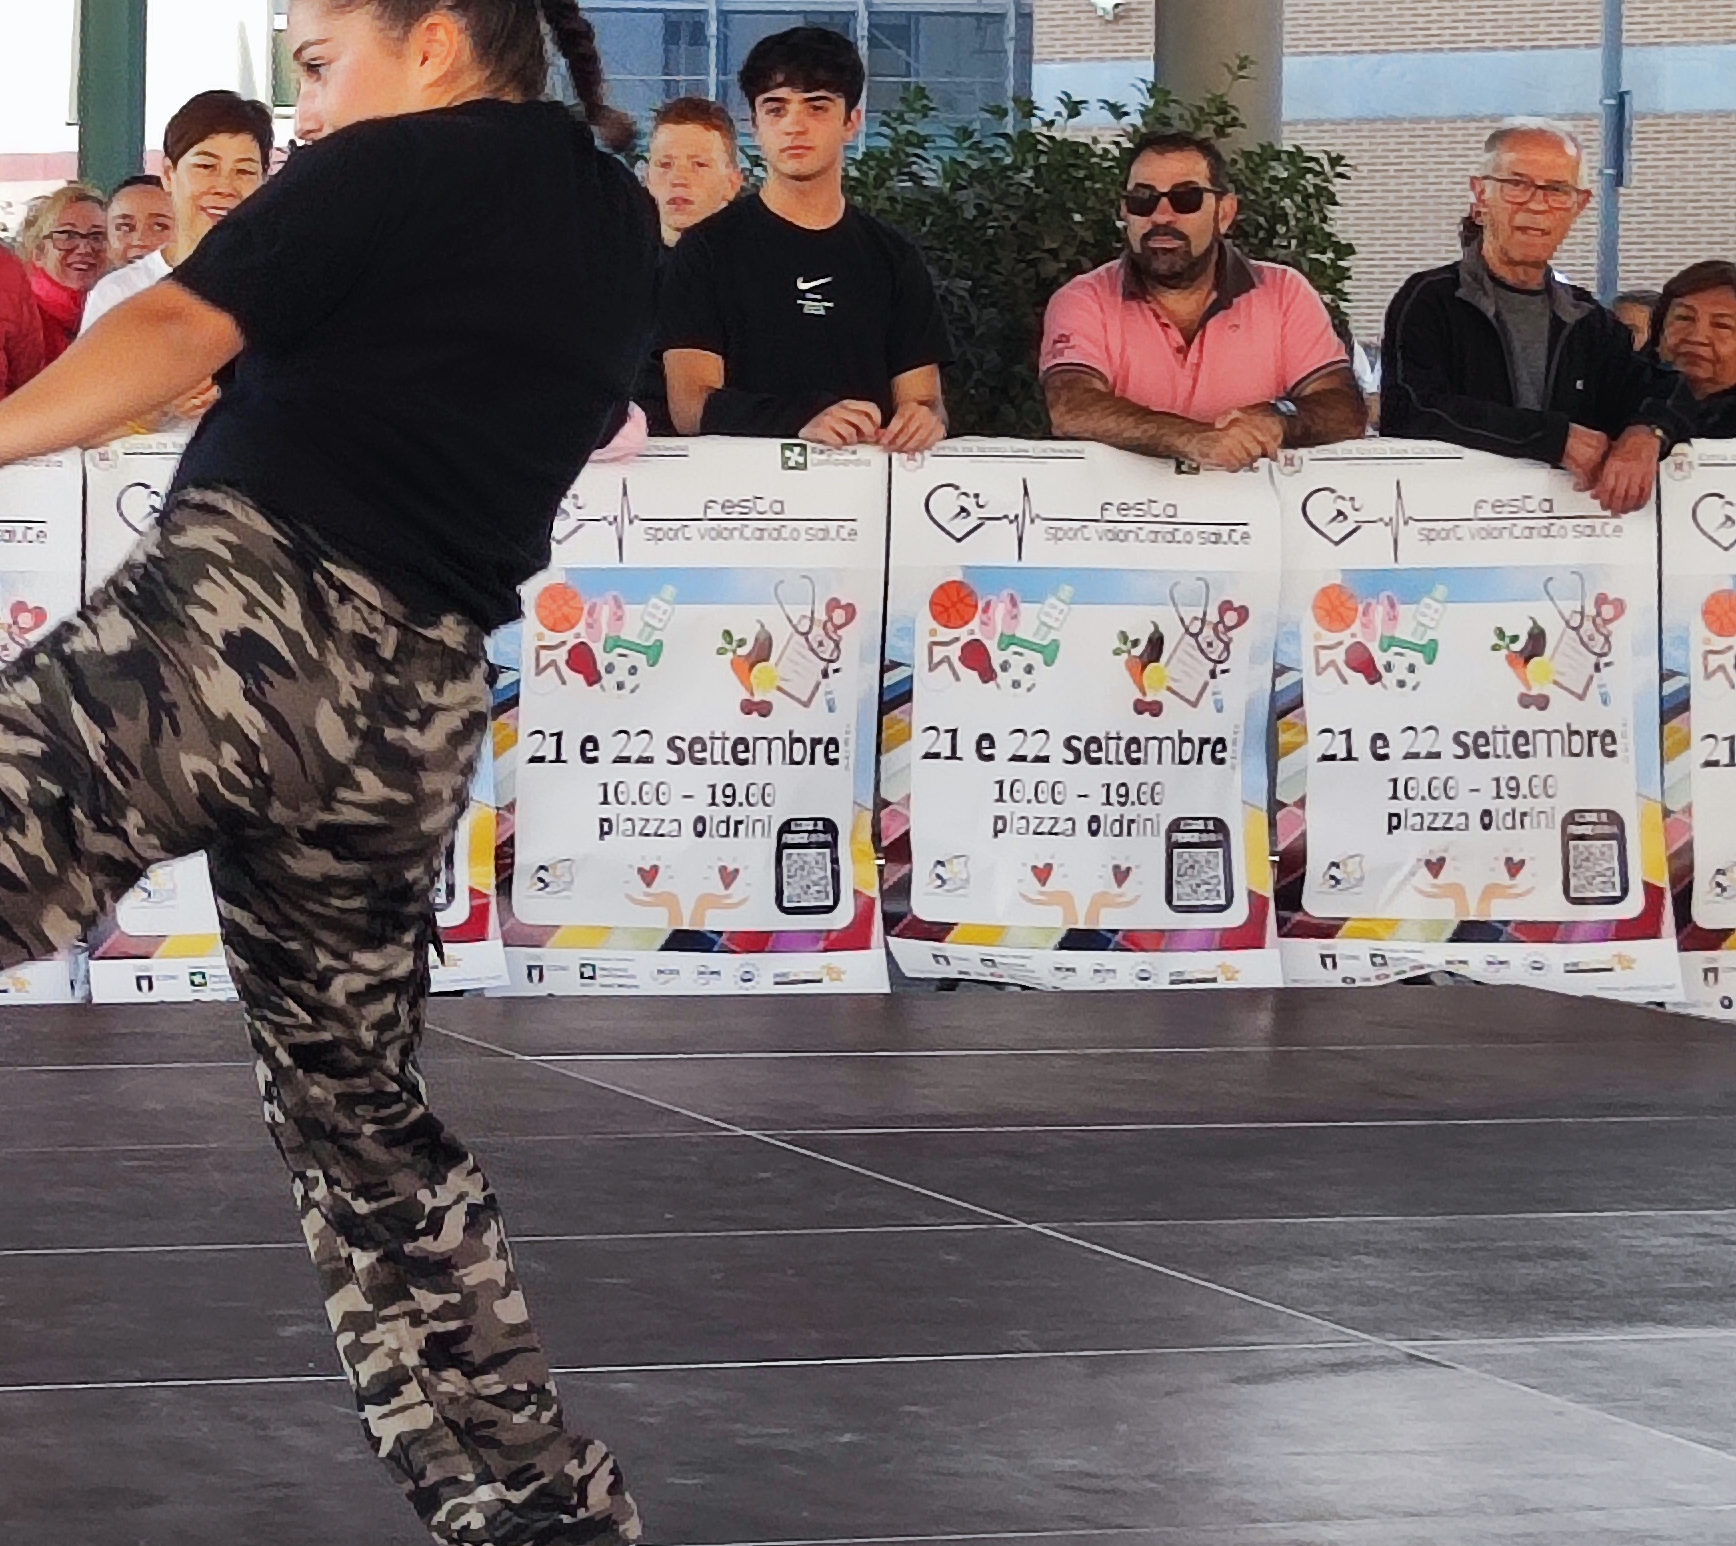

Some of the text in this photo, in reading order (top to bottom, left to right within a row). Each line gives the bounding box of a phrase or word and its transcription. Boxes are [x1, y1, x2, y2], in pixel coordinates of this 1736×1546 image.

[704, 495, 785, 519] festa
[1100, 498, 1178, 521] festa
[1473, 495, 1554, 518] festa
[643, 525, 692, 544] sport
[1045, 525, 1092, 545] sport
[1417, 525, 1463, 545] sport
[526, 729, 567, 764] 21
[580, 734, 599, 764] e
[611, 729, 655, 765] 22
[666, 730, 840, 766] settembre
[921, 726, 963, 761] 21
[975, 731, 996, 762] e
[1007, 728, 1050, 763] 22
[1063, 729, 1227, 766] settembre
[1316, 727, 1359, 762] 21
[1369, 732, 1390, 761] e
[1401, 725, 1442, 760] 22
[1452, 723, 1618, 759] settembre
[1700, 733, 1736, 768] 21
[597, 781, 671, 806] 10.00
[706, 782, 776, 807] 19.00
[993, 779, 1067, 805] 10.00
[1100, 781, 1164, 807] 19.00
[1387, 775, 1459, 801] 10.00
[1491, 774, 1558, 800] 19.00
[598, 813, 682, 841] piazza
[693, 814, 773, 839] Oldrini
[992, 812, 1076, 839] piazza
[1087, 813, 1161, 838] Oldrini
[1387, 808, 1469, 835] piazza
[1480, 806, 1556, 832] Oldrini
